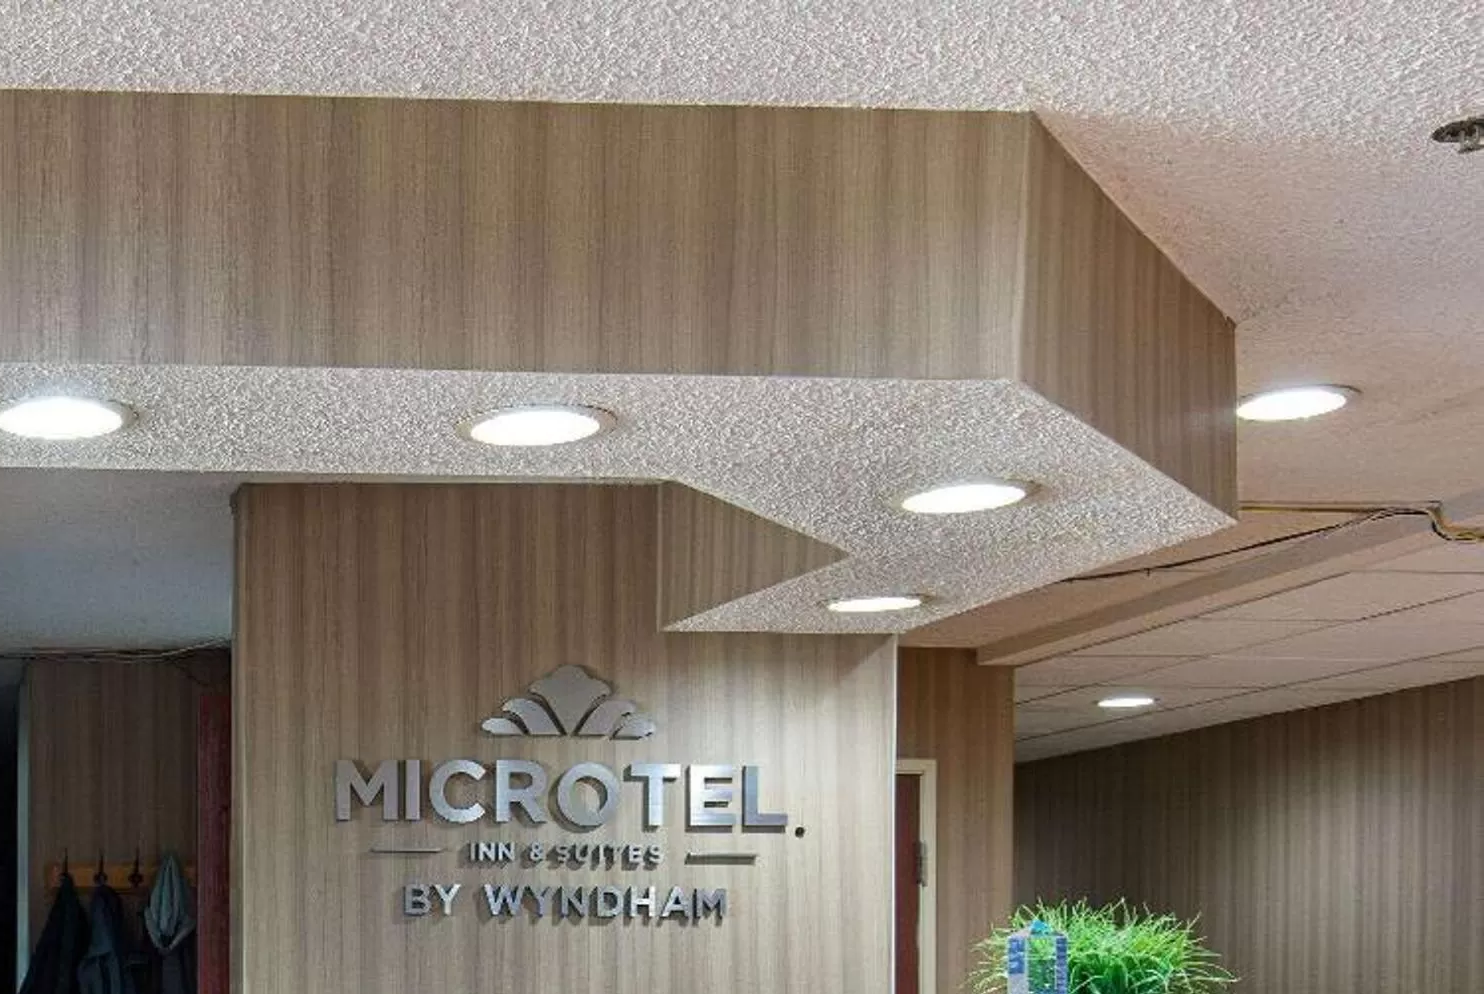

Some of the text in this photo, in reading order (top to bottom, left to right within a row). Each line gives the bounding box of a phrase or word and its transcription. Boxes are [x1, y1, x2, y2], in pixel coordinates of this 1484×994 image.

[335, 759, 788, 832] MICROTEL
[469, 841, 665, 866] INN & SUITES
[402, 882, 728, 922] BY WYNDHAM
